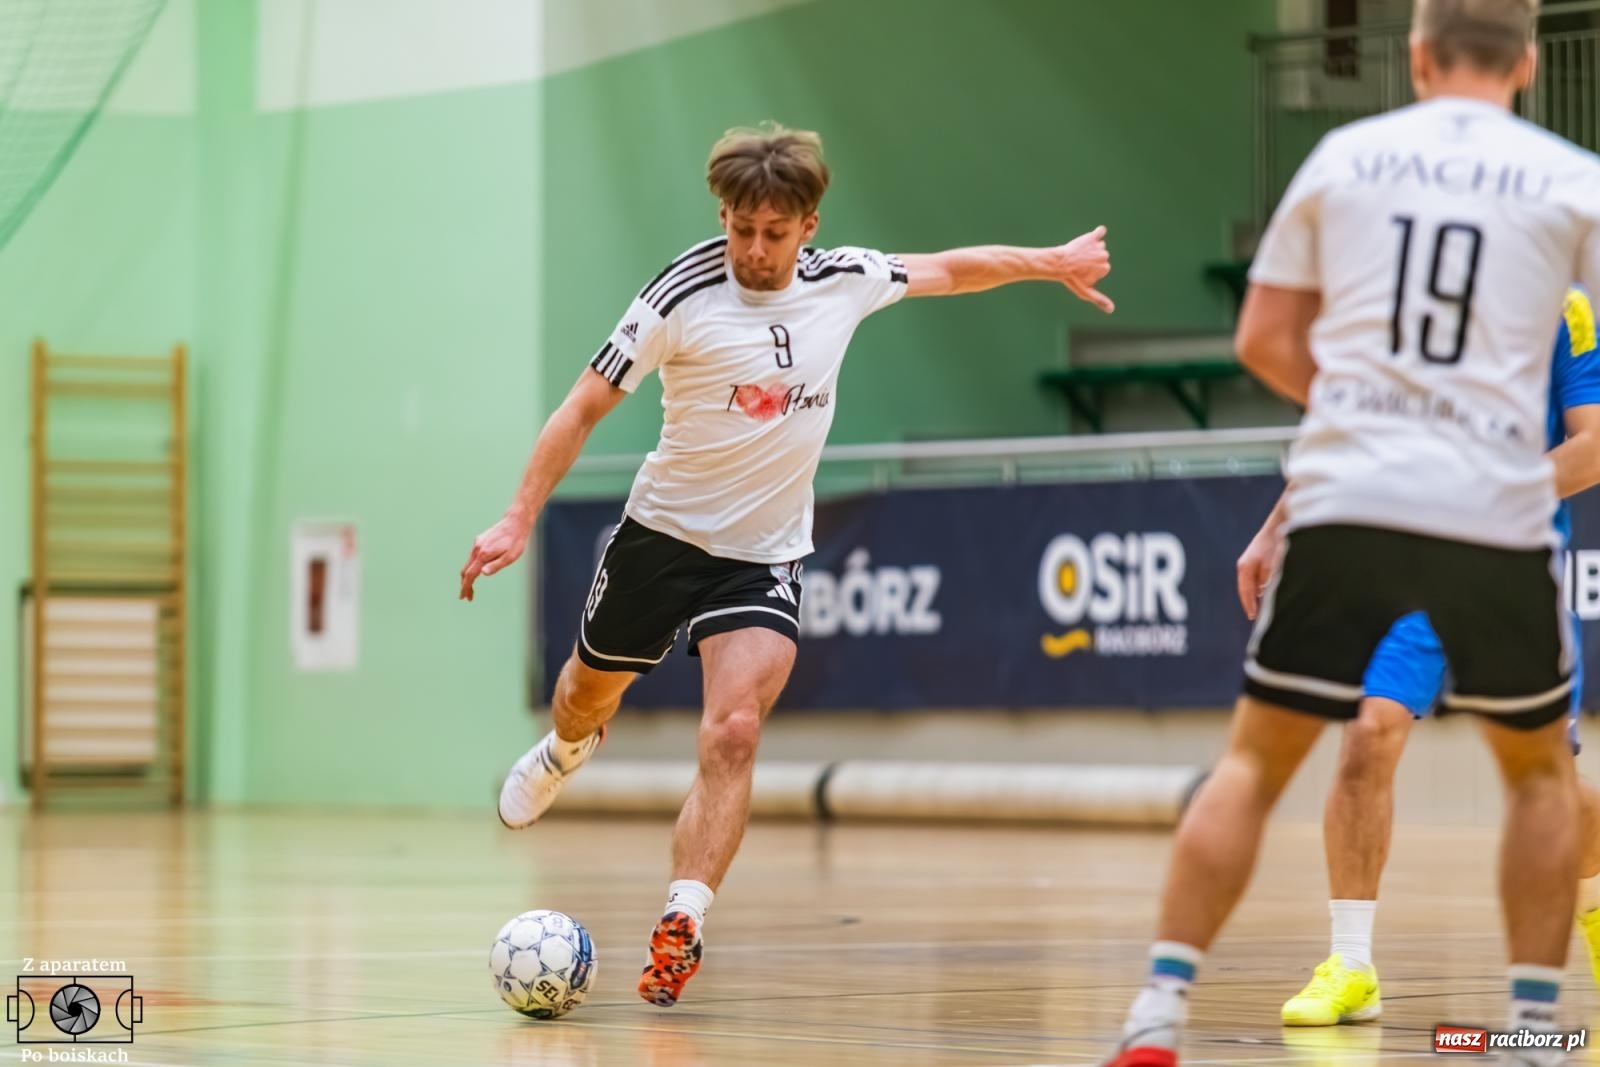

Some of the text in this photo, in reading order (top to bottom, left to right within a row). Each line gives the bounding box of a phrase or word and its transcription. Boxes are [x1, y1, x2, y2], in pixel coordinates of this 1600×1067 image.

[1390, 213, 1485, 366] 19
[769, 324, 793, 368] 9
[801, 549, 941, 636] BÓRZ
[1038, 532, 1187, 624] OSiR
